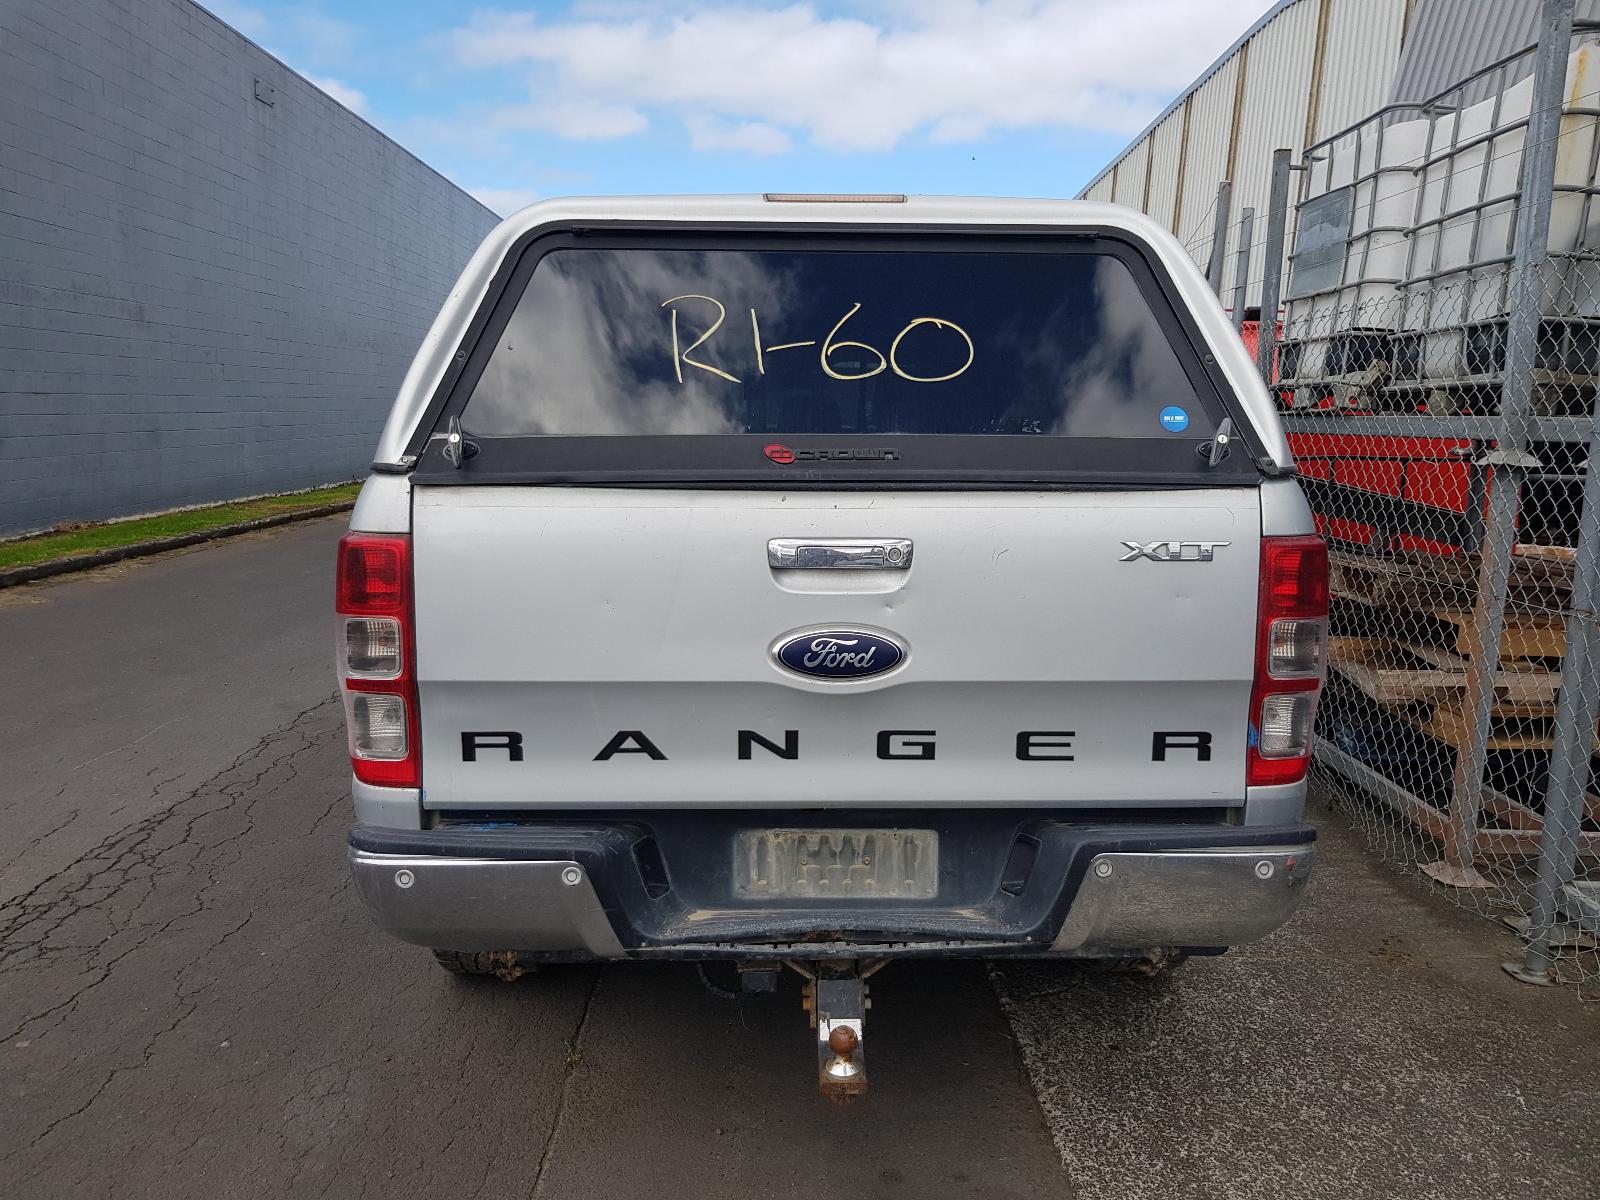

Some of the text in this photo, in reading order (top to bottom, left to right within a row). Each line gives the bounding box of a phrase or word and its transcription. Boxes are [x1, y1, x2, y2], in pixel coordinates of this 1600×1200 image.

[796, 448, 900, 461] CROWN
[1119, 541, 1233, 561] XLT
[803, 637, 877, 668] Ford
[461, 730, 1212, 761] RANGER
